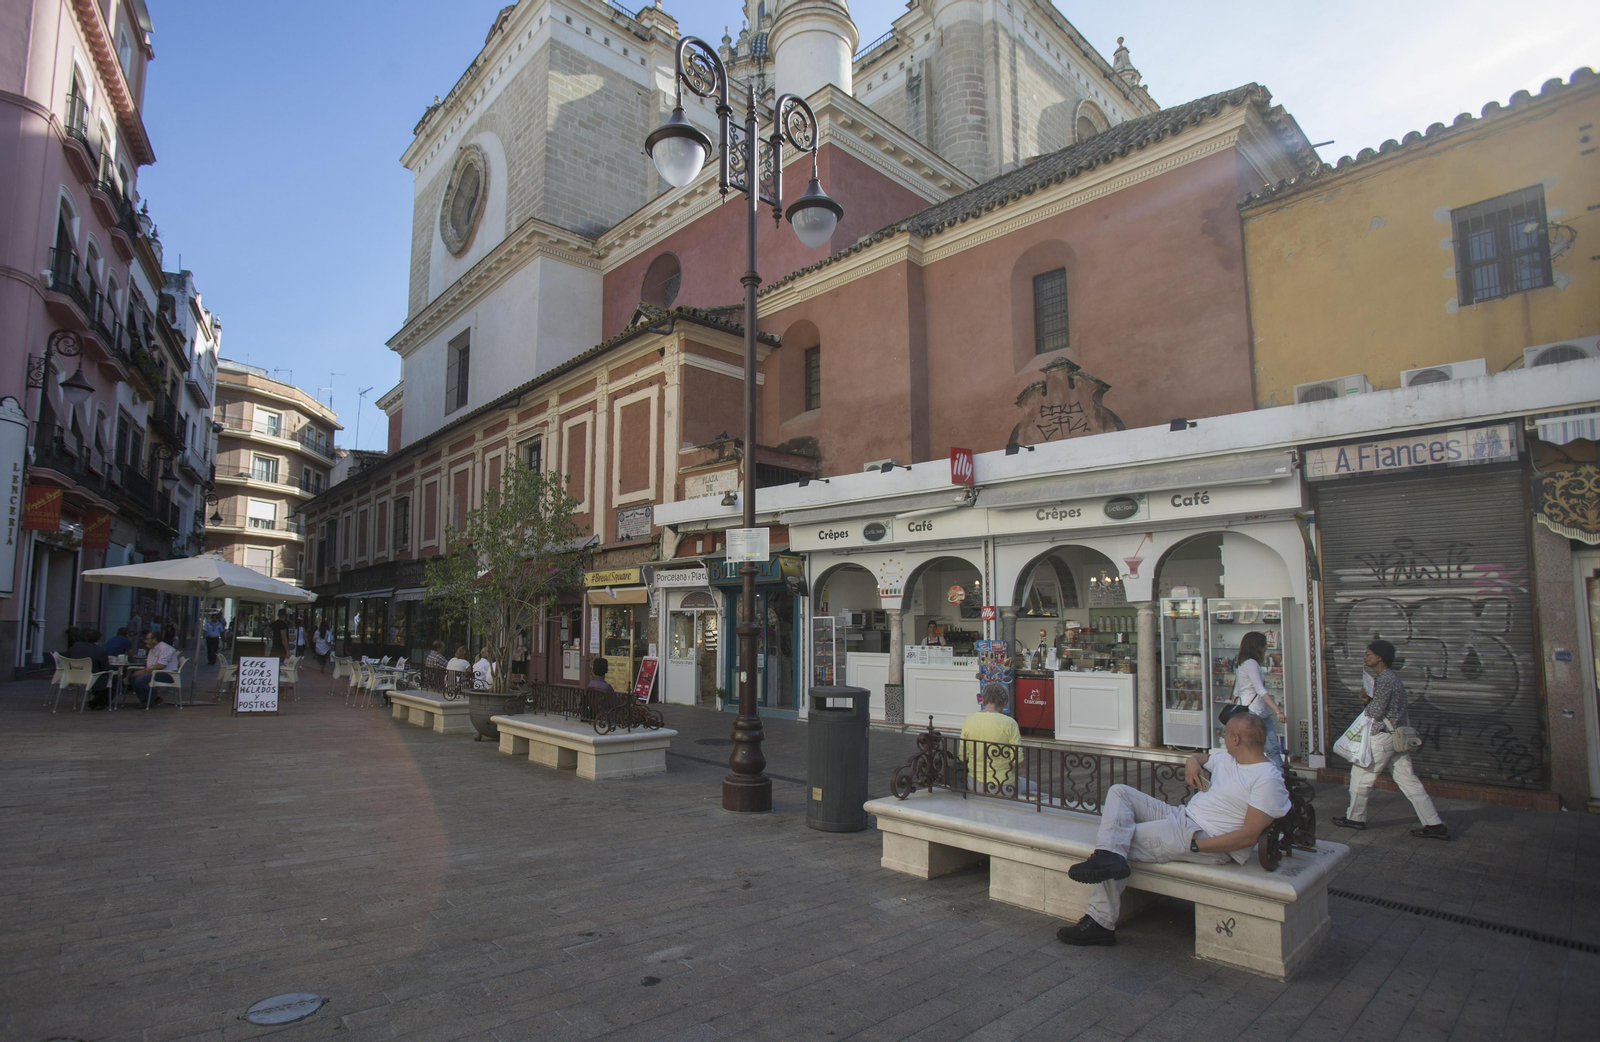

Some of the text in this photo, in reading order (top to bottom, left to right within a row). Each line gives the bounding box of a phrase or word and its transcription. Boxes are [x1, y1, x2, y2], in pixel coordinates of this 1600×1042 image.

[953, 453, 973, 481] illy
[702, 475, 718, 484] PLAZA
[706, 484, 714, 492] DE
[6, 463, 20, 545] LENCERIA
[1036, 491, 1210, 521] Crêpes Café
[1106, 504, 1136, 513] Delicious
[818, 520, 933, 540] Crêpes Café
[656, 573, 687, 583] Porcelana
[982, 607, 994, 619] illy
[241, 669, 271, 677] COPAS
[241, 678, 272, 686] COCTEL
[240, 686, 276, 694] HELADOS
